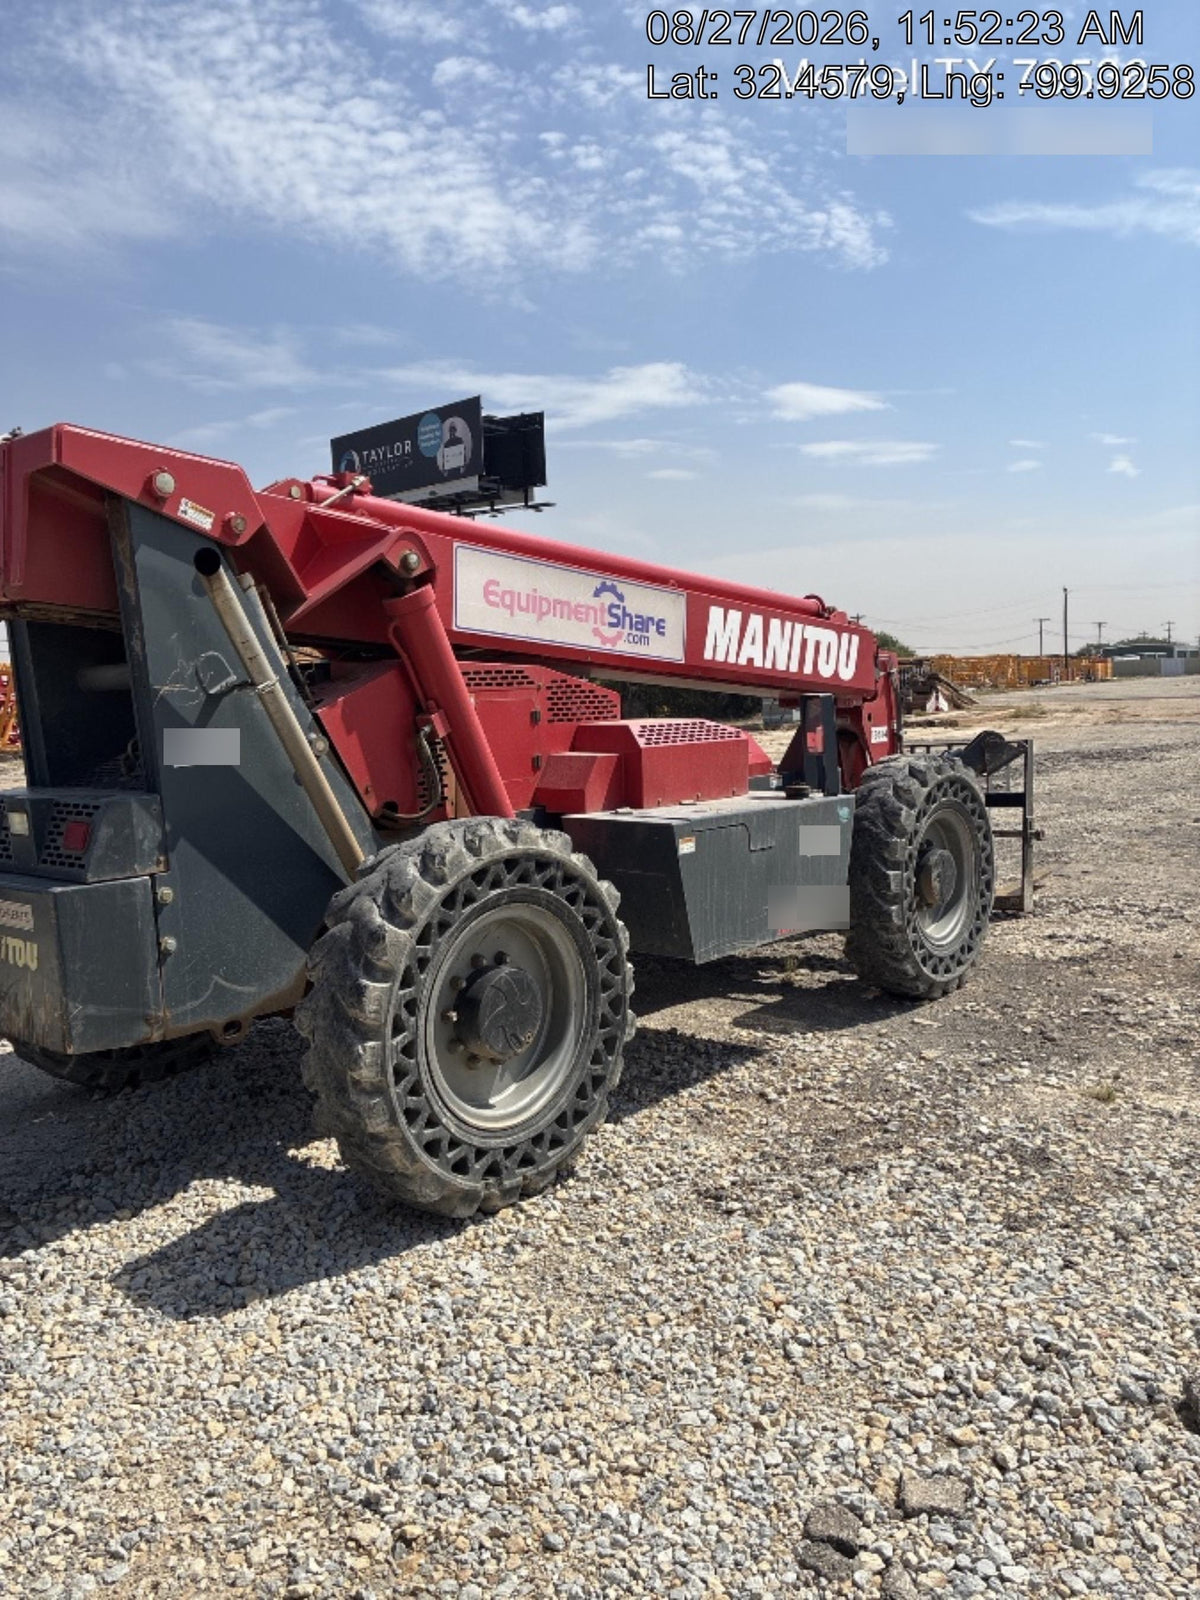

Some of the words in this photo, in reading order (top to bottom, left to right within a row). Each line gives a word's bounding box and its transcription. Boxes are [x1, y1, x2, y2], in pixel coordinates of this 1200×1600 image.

[361, 439, 412, 466] TAYLOR
[482, 578, 666, 637] EquipmentShare
[623, 632, 650, 647] .com
[703, 605, 860, 682] MANITOU
